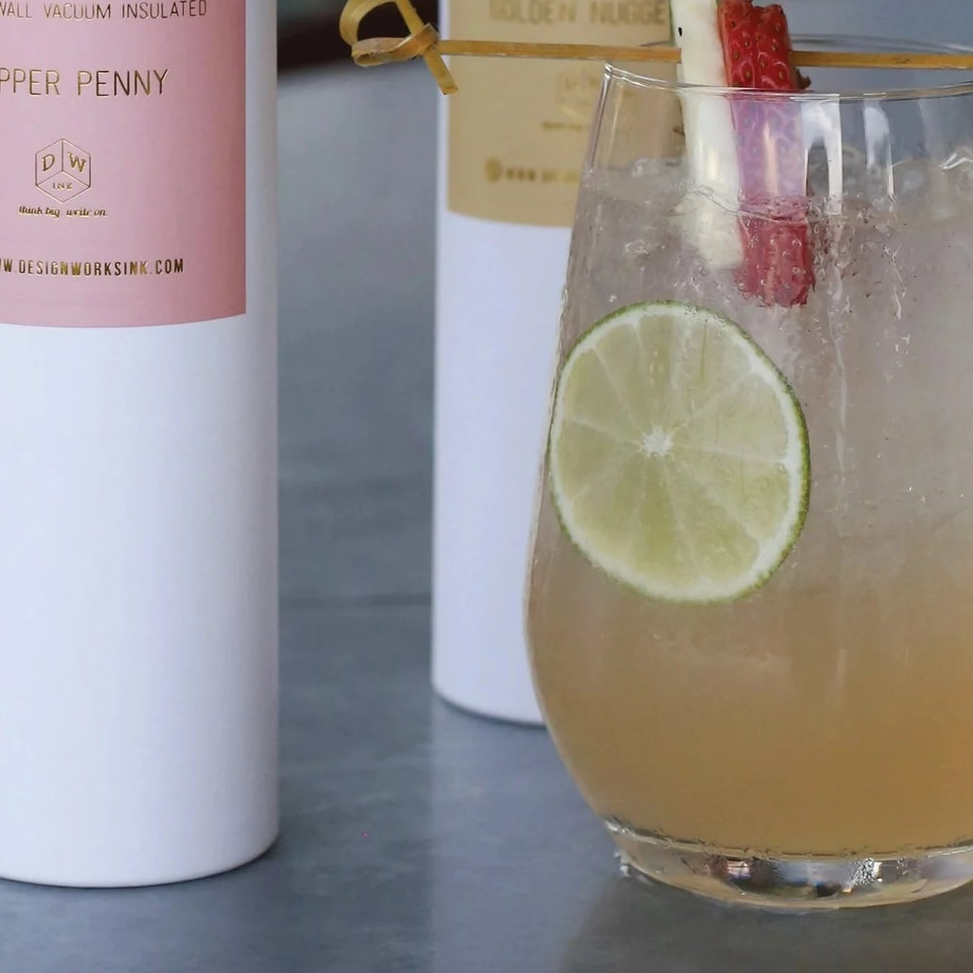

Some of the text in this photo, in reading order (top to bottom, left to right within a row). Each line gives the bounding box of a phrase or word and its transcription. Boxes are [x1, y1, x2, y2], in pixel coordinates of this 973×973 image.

[43, 2, 111, 20] VACUUM
[122, 0, 207, 20] INSULATED
[76, 68, 169, 97] PENNY
[52, 181, 73, 191] INK
[18, 205, 43, 216] think
[66, 207, 91, 217] write
